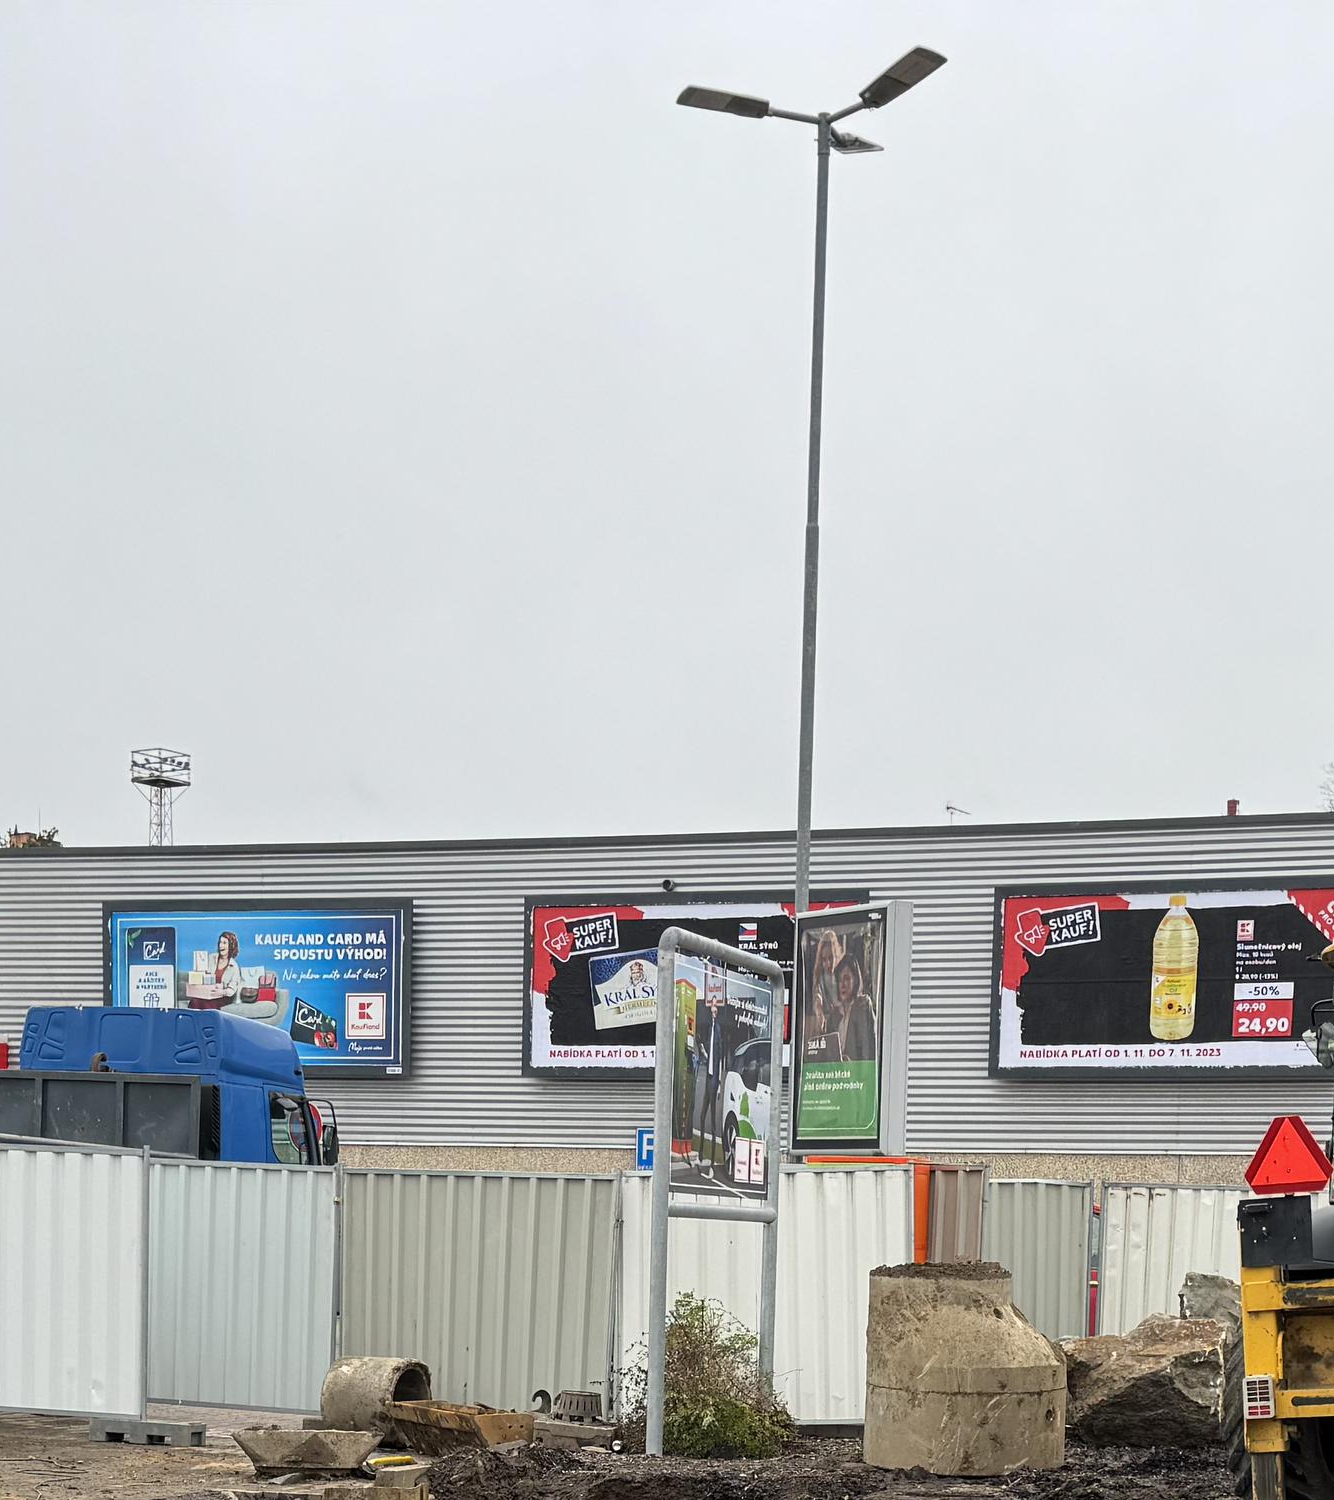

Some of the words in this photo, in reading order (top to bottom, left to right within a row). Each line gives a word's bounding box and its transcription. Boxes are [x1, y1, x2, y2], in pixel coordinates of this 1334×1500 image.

[573, 918, 612, 937] SUPER
[1049, 909, 1093, 930] SUPER
[255, 933, 323, 945] KAUFLAND
[327, 933, 362, 945] CARD
[366, 930, 386, 945] MÁ
[575, 929, 613, 949] KAUF!
[1051, 920, 1095, 942] KAUF!
[274, 948, 332, 960] SPOUSTU
[336, 946, 387, 960] VÝHOD!
[738, 942, 758, 950] KRÁL
[1287, 942, 1302, 951] olej
[604, 986, 640, 1006] KRÁL
[1248, 985, 1280, 996] -50%
[359, 1003, 373, 1020] K
[1236, 1002, 1266, 1012] 49,90
[298, 1008, 323, 1026] Card
[1238, 1017, 1289, 1034] 24,90
[549, 1048, 592, 1058] NABÍDKA
[595, 1048, 622, 1058] PLATÍ
[624, 1050, 639, 1058] OD
[1019, 1048, 1068, 1058] NABÍDKA
[1071, 1048, 1102, 1058] PLATÍ
[1105, 1049, 1120, 1058] OD
[1149, 1049, 1165, 1057] DO
[1181, 1048, 1192, 1057] 11.
[1196, 1048, 1221, 1057] 2023
